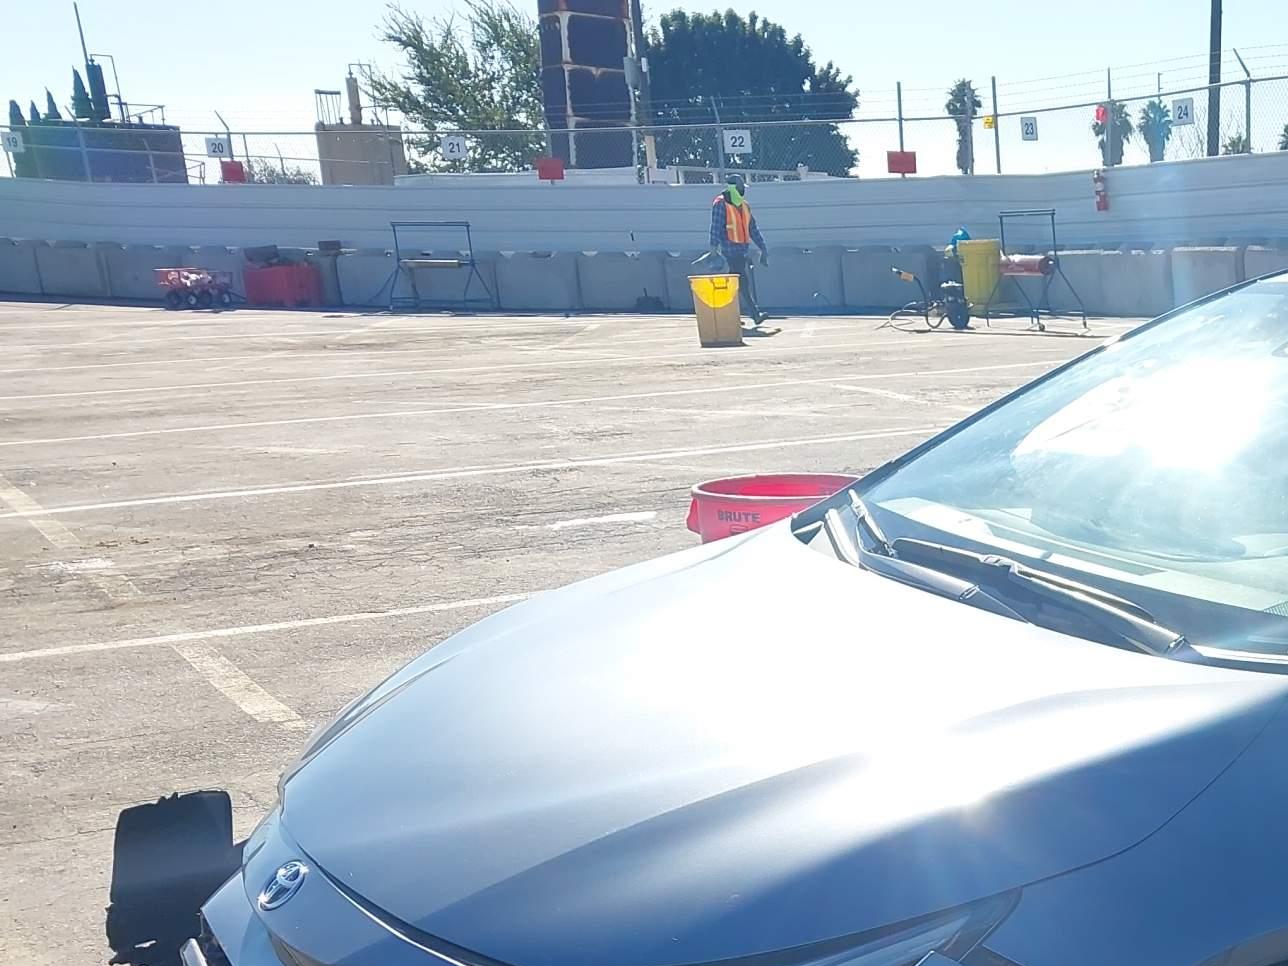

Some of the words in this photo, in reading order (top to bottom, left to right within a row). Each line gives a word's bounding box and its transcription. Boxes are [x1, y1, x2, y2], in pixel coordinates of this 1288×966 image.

[1177, 105, 1189, 120] 24
[1024, 122, 1034, 136] 23
[6, 136, 18, 148] 19
[211, 142, 224, 154] 20
[448, 142, 461, 154] 21
[730, 136, 745, 148] 22
[717, 510, 761, 523] BRUTE
